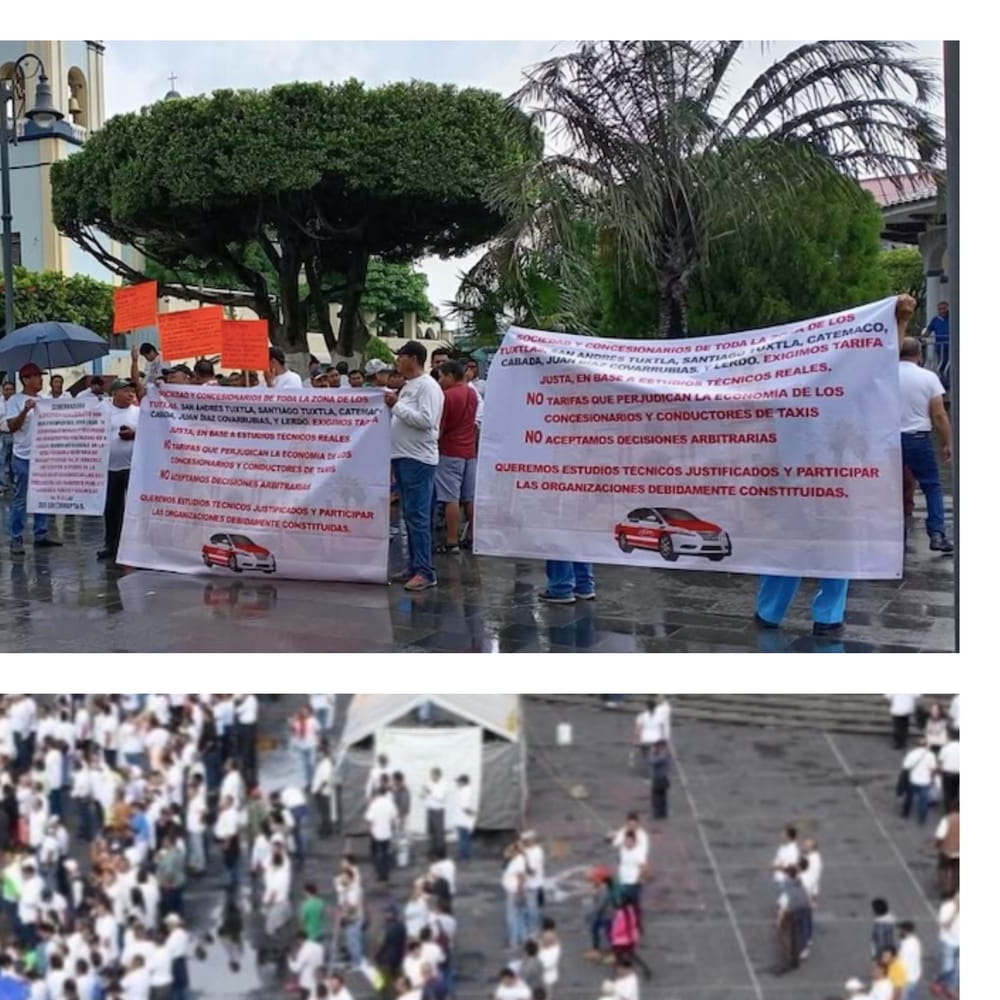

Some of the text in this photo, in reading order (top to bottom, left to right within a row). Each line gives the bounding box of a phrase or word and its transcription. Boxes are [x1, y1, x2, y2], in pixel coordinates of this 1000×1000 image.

[585, 342, 692, 353] CONCESIONARIOS
[695, 344, 712, 352] DE
[716, 340, 747, 351] TODA
[808, 320, 825, 331] DE
[828, 313, 856, 326] LOS
[807, 322, 889, 344] CATEMACO,
[546, 355, 576, 366] JUAN
[763, 344, 829, 363] EXIGIMOS
[832, 337, 883, 350] TARIFA
[539, 374, 575, 385] JUSTA,
[576, 374, 591, 384] EN
[594, 374, 623, 383] BASE
[775, 362, 832, 379] REALES.
[311, 395, 336, 403] ZONA
[526, 392, 544, 405] NO
[546, 394, 590, 406] TARIFAS
[591, 394, 615, 405] QUE
[616, 393, 692, 404] PERJUDICAN
[695, 391, 712, 401] LA
[792, 387, 813, 398] DE
[815, 386, 845, 397] LOS
[258, 406, 299, 415] SANTIAGO
[544, 407, 820, 424] CONCESIONARIOS Y CONDUCTORES DE TAXIS
[209, 430, 228, 438] BASE
[525, 430, 777, 445] NO ACEPTAMOS DECISIONES ARBITRARIAS
[201, 446, 218, 454] QUE
[243, 462, 302, 472] CONDUCTORES
[495, 463, 559, 474] QUEREMOS
[562, 465, 621, 476] ESTUDIOS
[685, 466, 780, 477] JUSTIFICADOS
[783, 467, 792, 477] Y
[796, 467, 880, 478] PARTICIPAR
[211, 477, 258, 487] DECISIONES
[516, 480, 849, 498] LAS ORGANIZACIONES DEBIDAMENTE CONSTITUIDAS.
[252, 505, 309, 515] JUSTIFICADOS
[319, 508, 375, 519] PARTICIPAR
